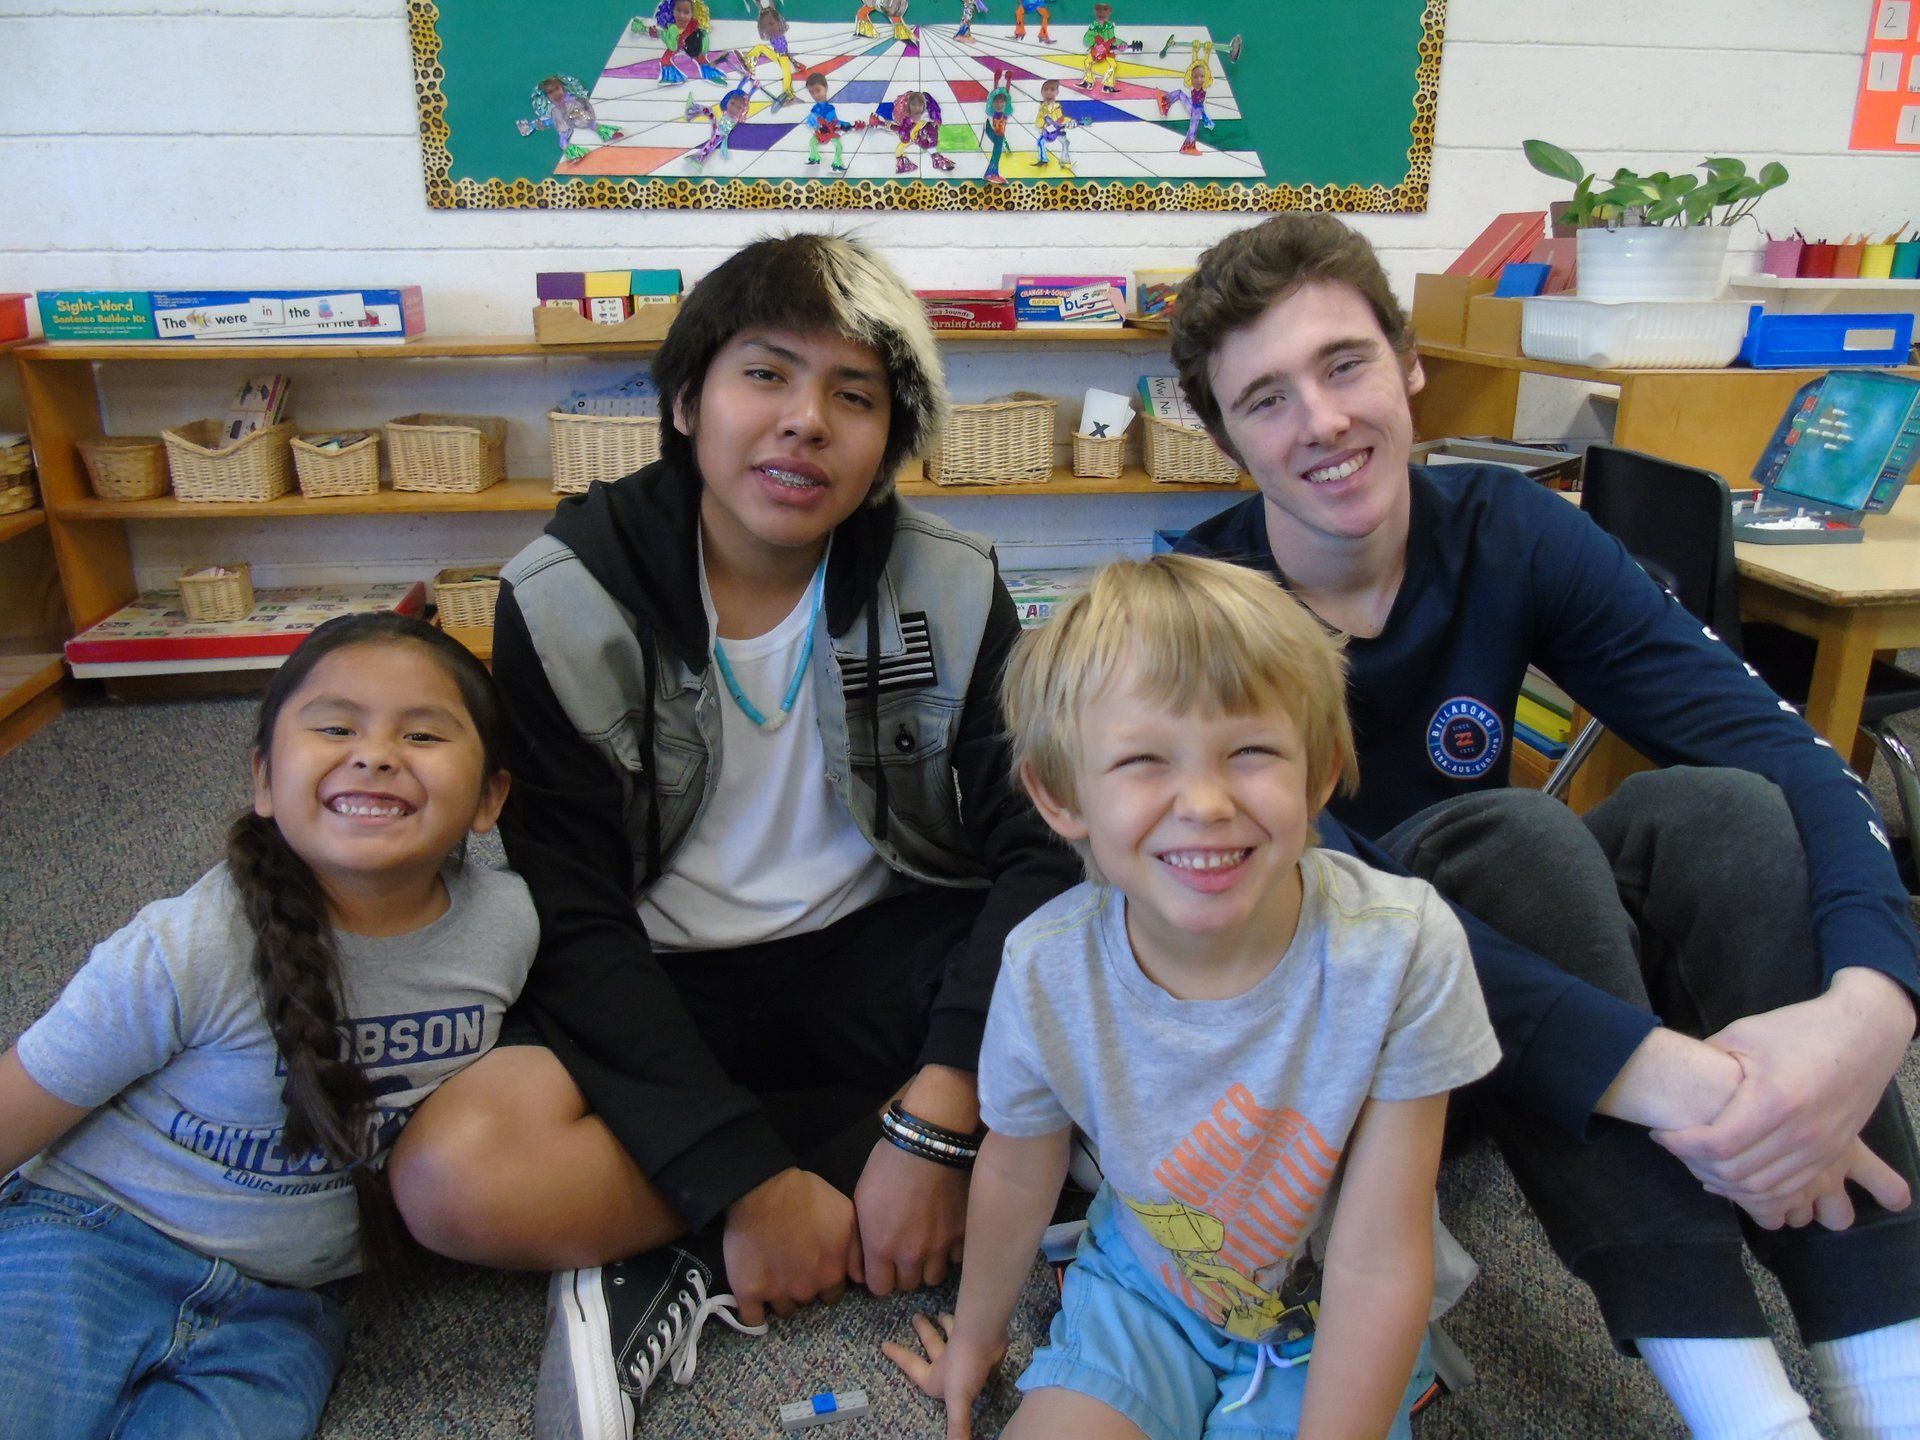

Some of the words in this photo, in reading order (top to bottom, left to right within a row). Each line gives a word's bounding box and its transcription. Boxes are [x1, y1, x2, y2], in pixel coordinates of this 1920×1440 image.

[1884, 7, 1897, 29] 2
[1020, 289, 1072, 298] CHANGE-A-SOUND
[56, 298, 134, 315] Sight-Word
[52, 314, 96, 324] Sentence
[97, 313, 131, 323] Builder
[132, 314, 147, 323] Kit
[162, 317, 187, 329] The
[215, 314, 248, 325] were
[262, 305, 273, 317] in
[289, 307, 311, 319] the
[969, 319, 1002, 330] Center
[1160, 401, 1171, 415] Nn
[1431, 703, 1495, 737] BILLABONG
[1153, 1082, 1280, 1206] UNDER
[223, 1168, 320, 1196] EDUCATION
